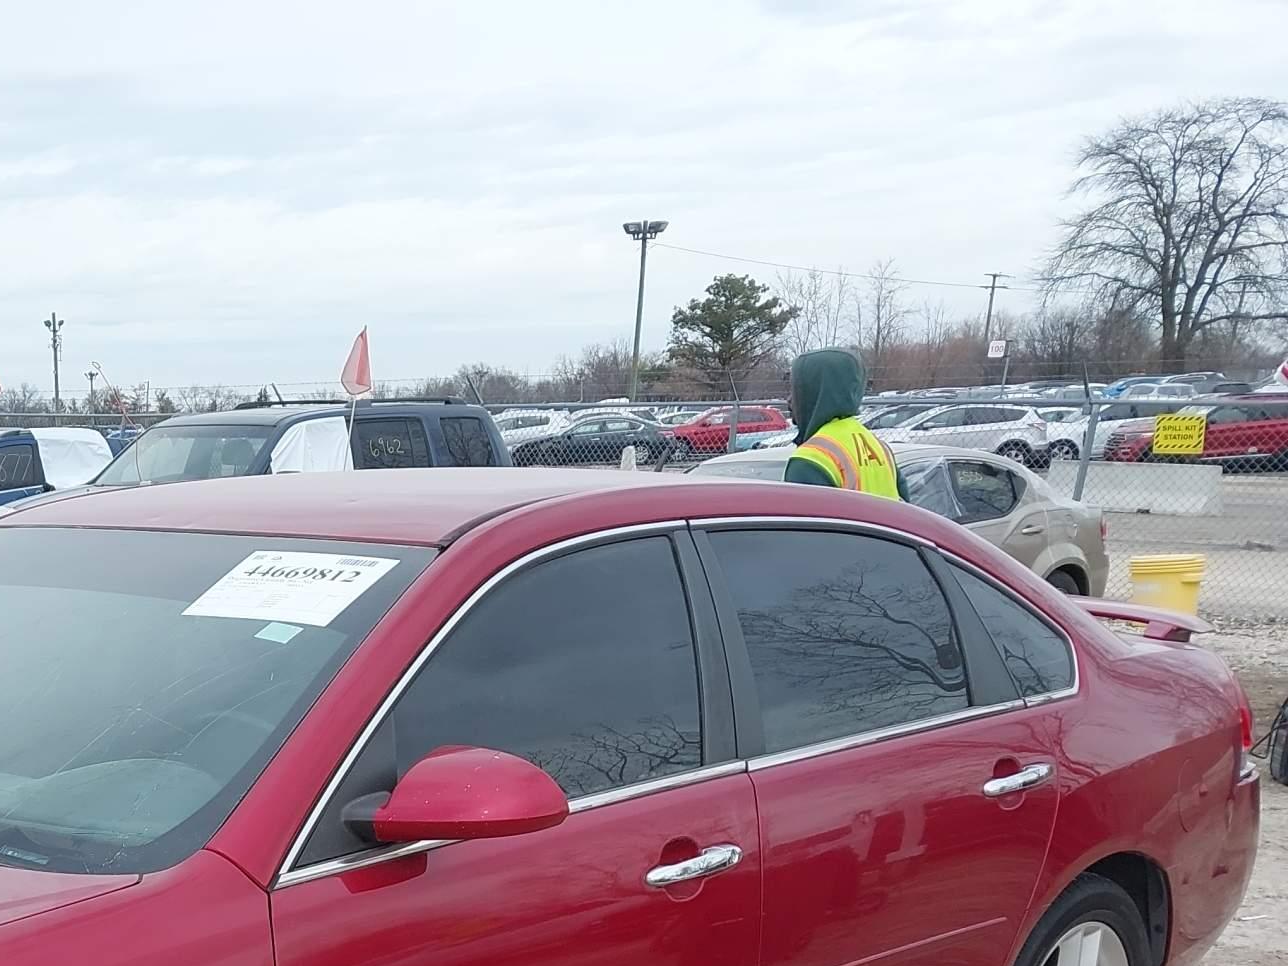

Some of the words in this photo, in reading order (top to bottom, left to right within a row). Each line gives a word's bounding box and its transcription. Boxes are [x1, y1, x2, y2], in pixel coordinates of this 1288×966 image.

[1162, 424, 1182, 432] SPILL
[1185, 424, 1198, 432] KIT
[1163, 433, 1194, 441] STATION
[369, 437, 405, 457] 6962
[243, 564, 361, 583] 44669812
